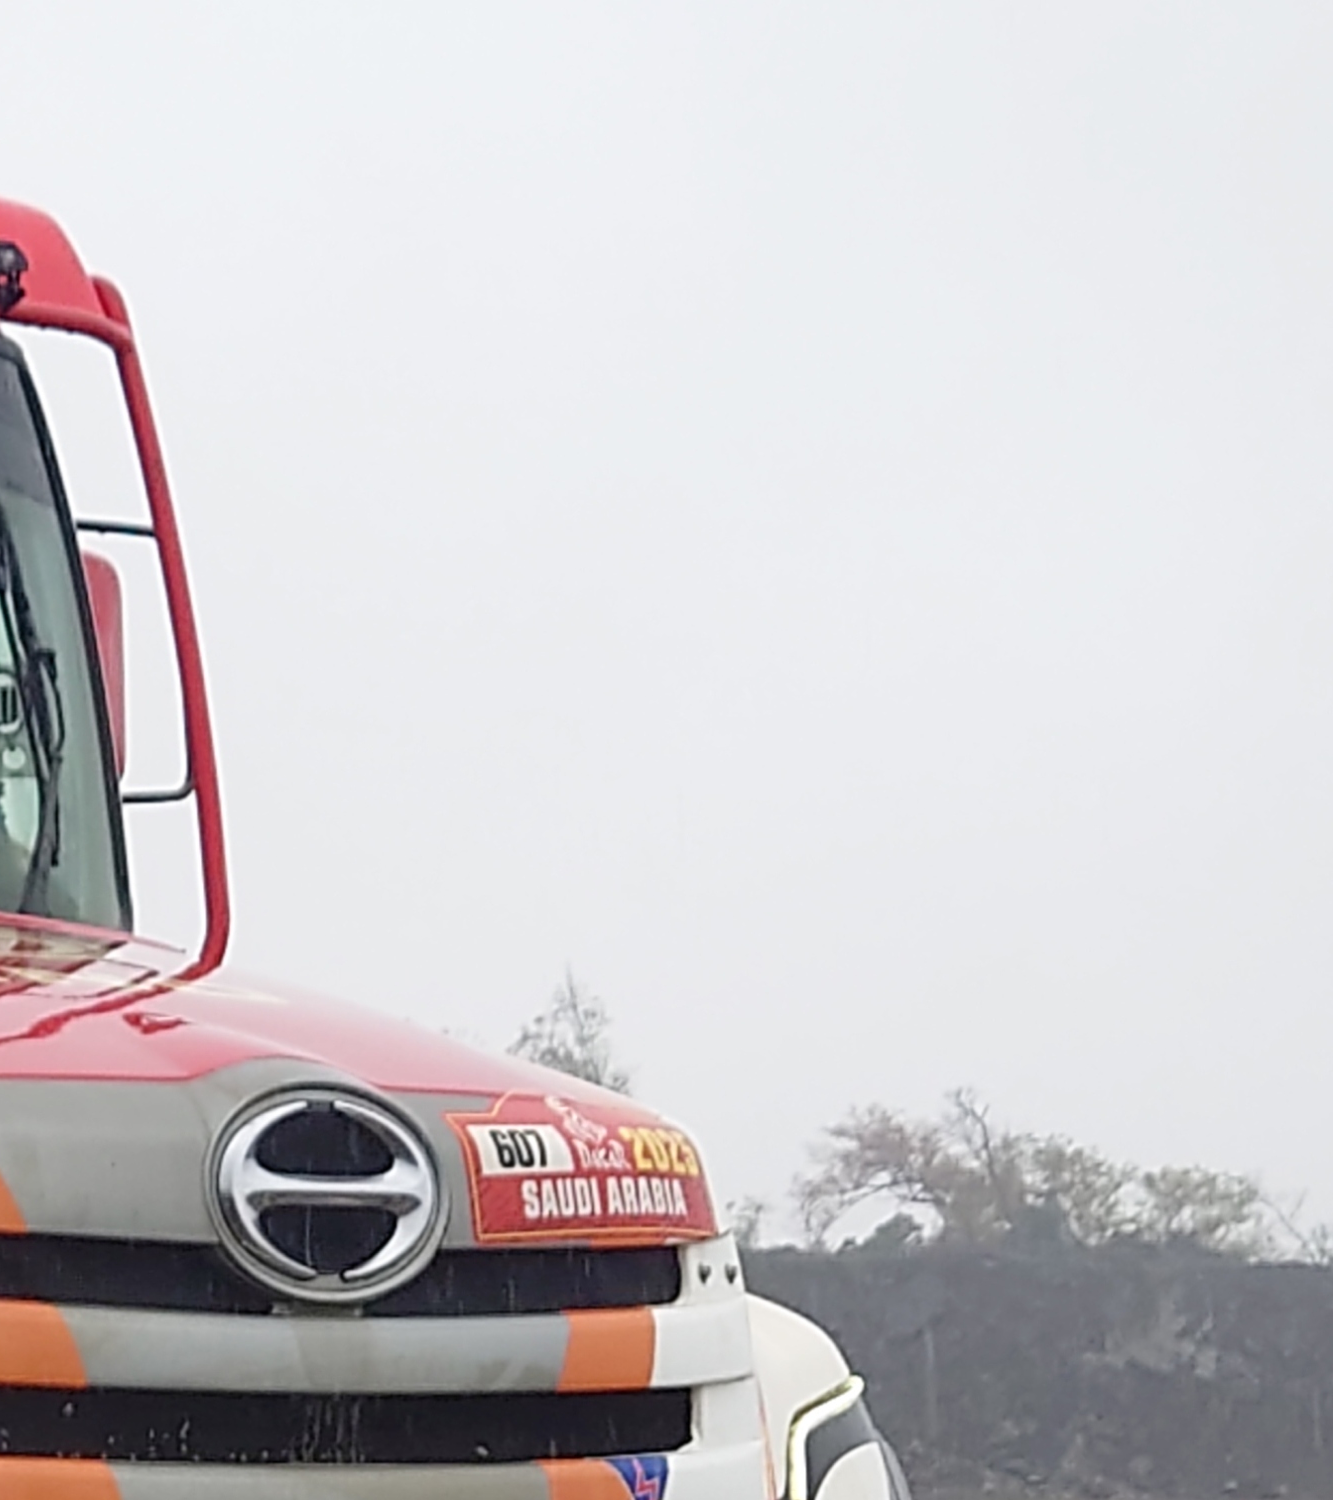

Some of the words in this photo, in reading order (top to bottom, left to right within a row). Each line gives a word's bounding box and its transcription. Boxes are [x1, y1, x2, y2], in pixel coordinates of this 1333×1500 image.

[489, 1129, 548, 1168] 607
[619, 1126, 700, 1177] 2025
[521, 1175, 602, 1219] SAUDI
[606, 1175, 688, 1217] ARABIA
